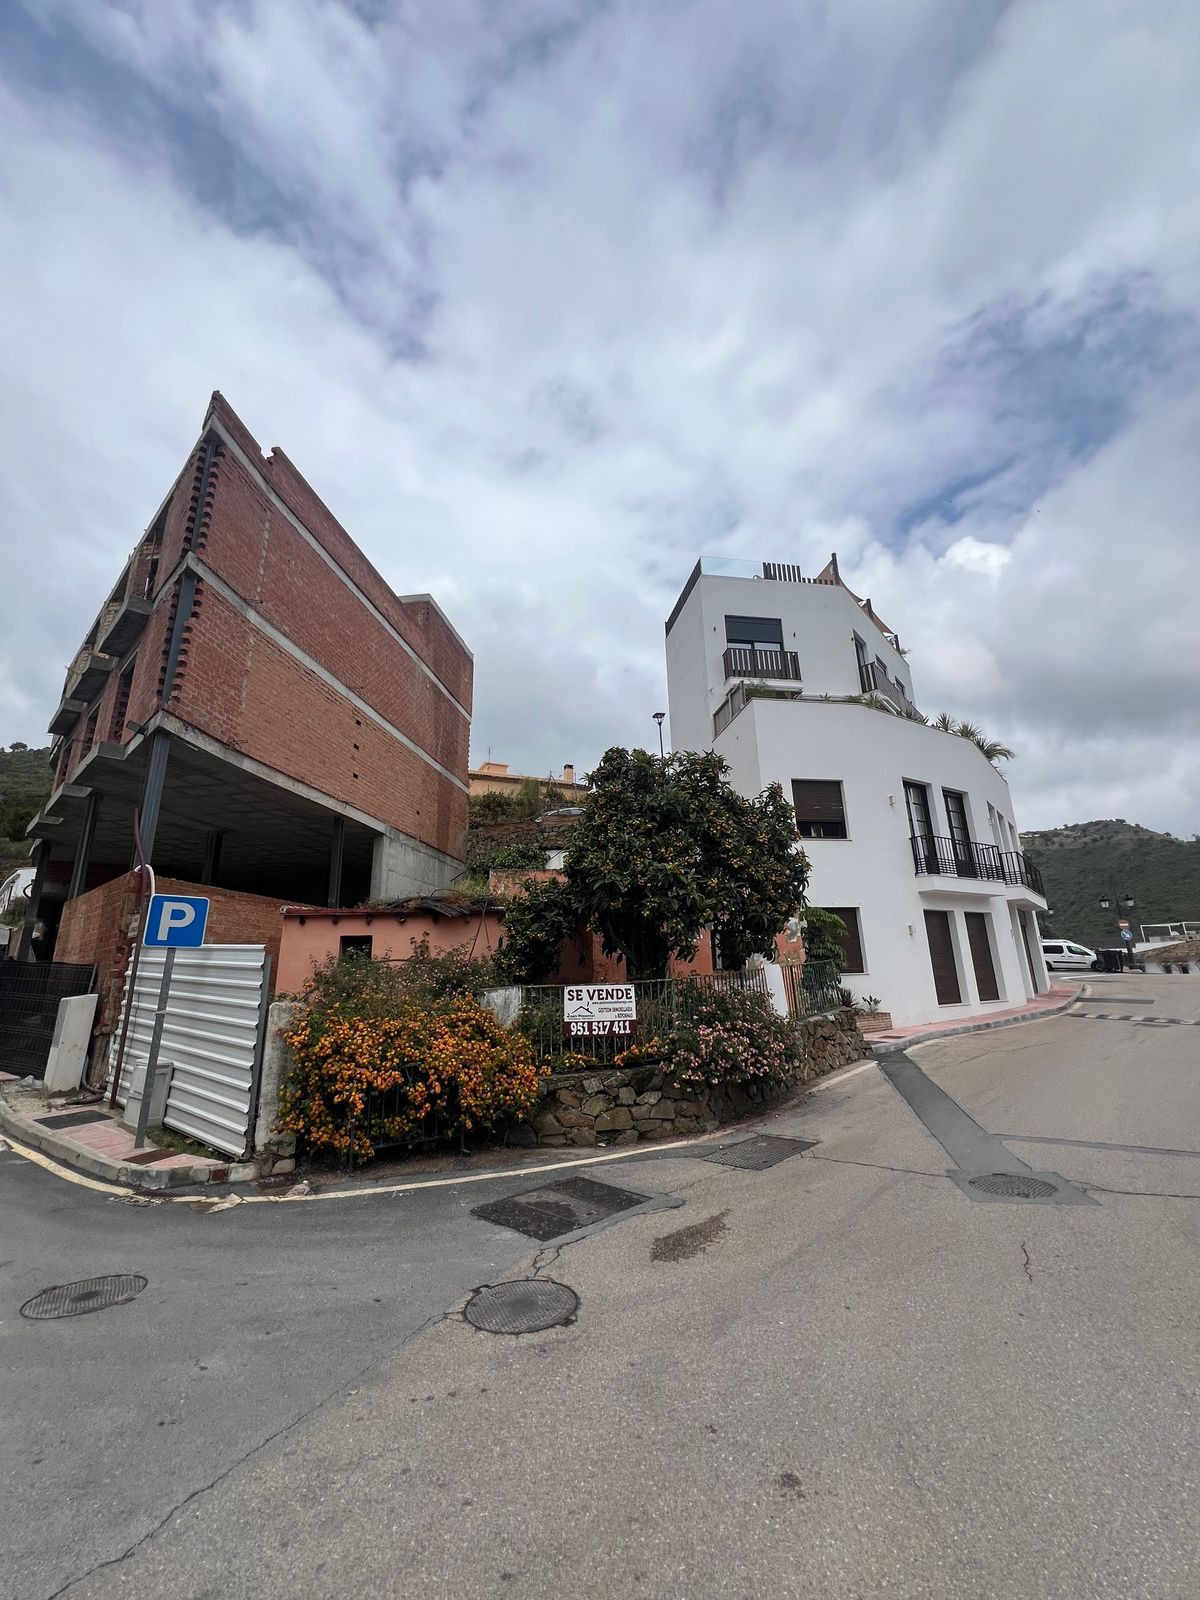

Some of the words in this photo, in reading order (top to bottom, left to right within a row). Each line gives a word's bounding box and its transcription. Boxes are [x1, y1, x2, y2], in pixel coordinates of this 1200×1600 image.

[157, 902, 195, 941] P
[568, 989, 583, 1001] SE
[586, 988, 632, 1000] VENDE
[570, 1022, 589, 1036] 951
[592, 1021, 610, 1035] 517
[612, 1020, 631, 1034] 411
